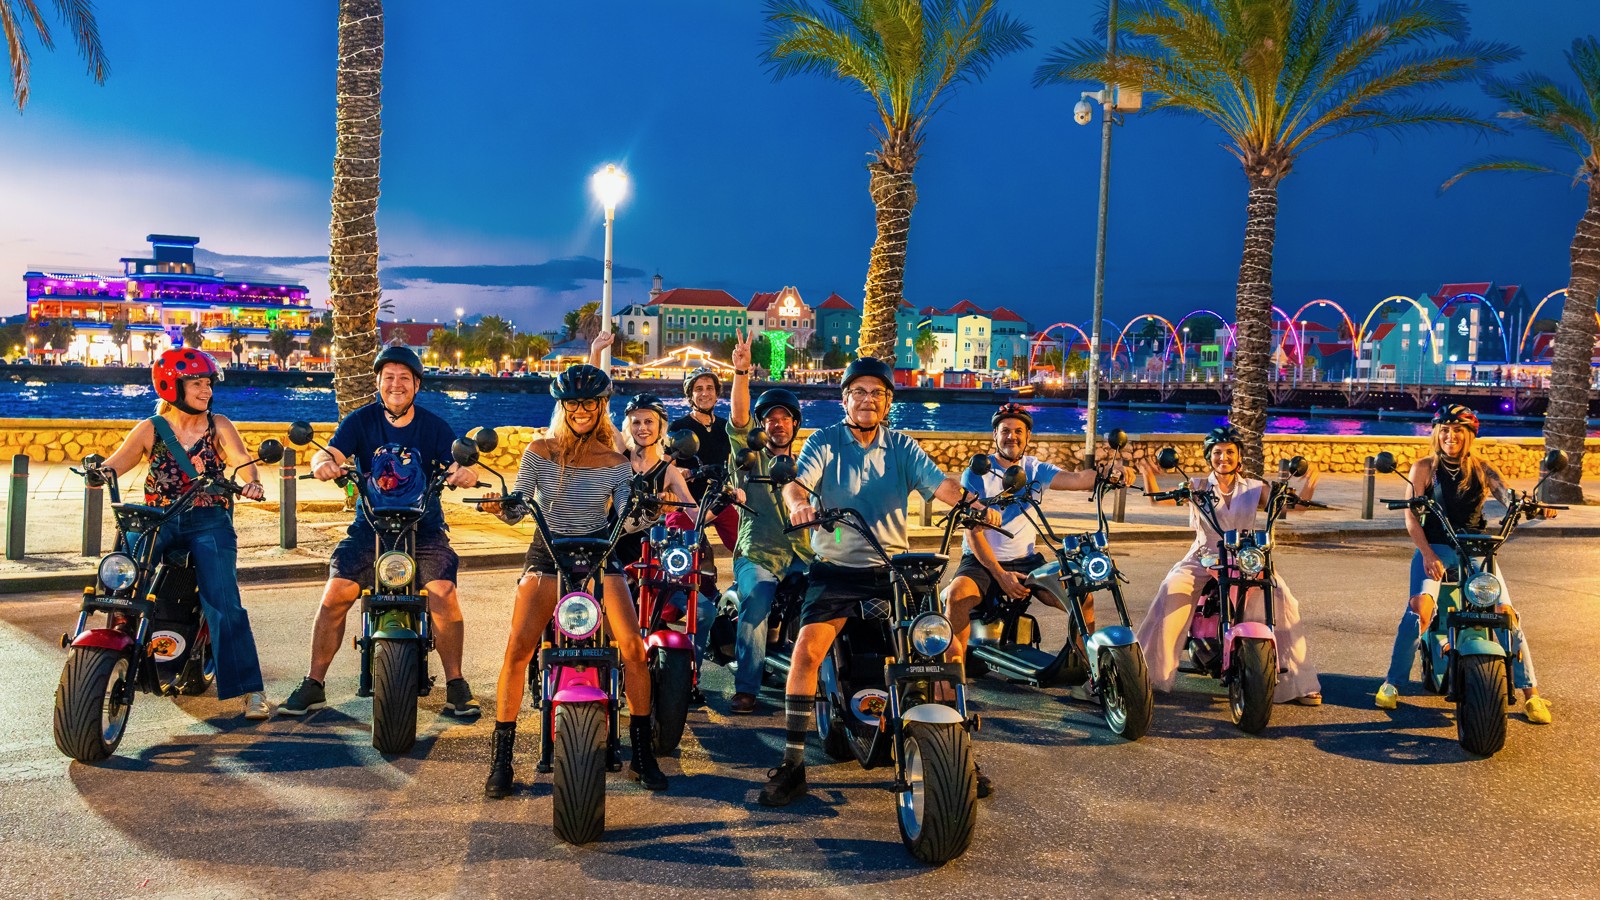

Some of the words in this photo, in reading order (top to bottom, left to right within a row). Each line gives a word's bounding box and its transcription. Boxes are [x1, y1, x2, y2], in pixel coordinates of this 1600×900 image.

[558, 649, 580, 657] SPYDER
[582, 649, 604, 657] WHEELZ
[909, 665, 925, 673] SPYDER
[925, 665, 941, 673] WHEELZ
